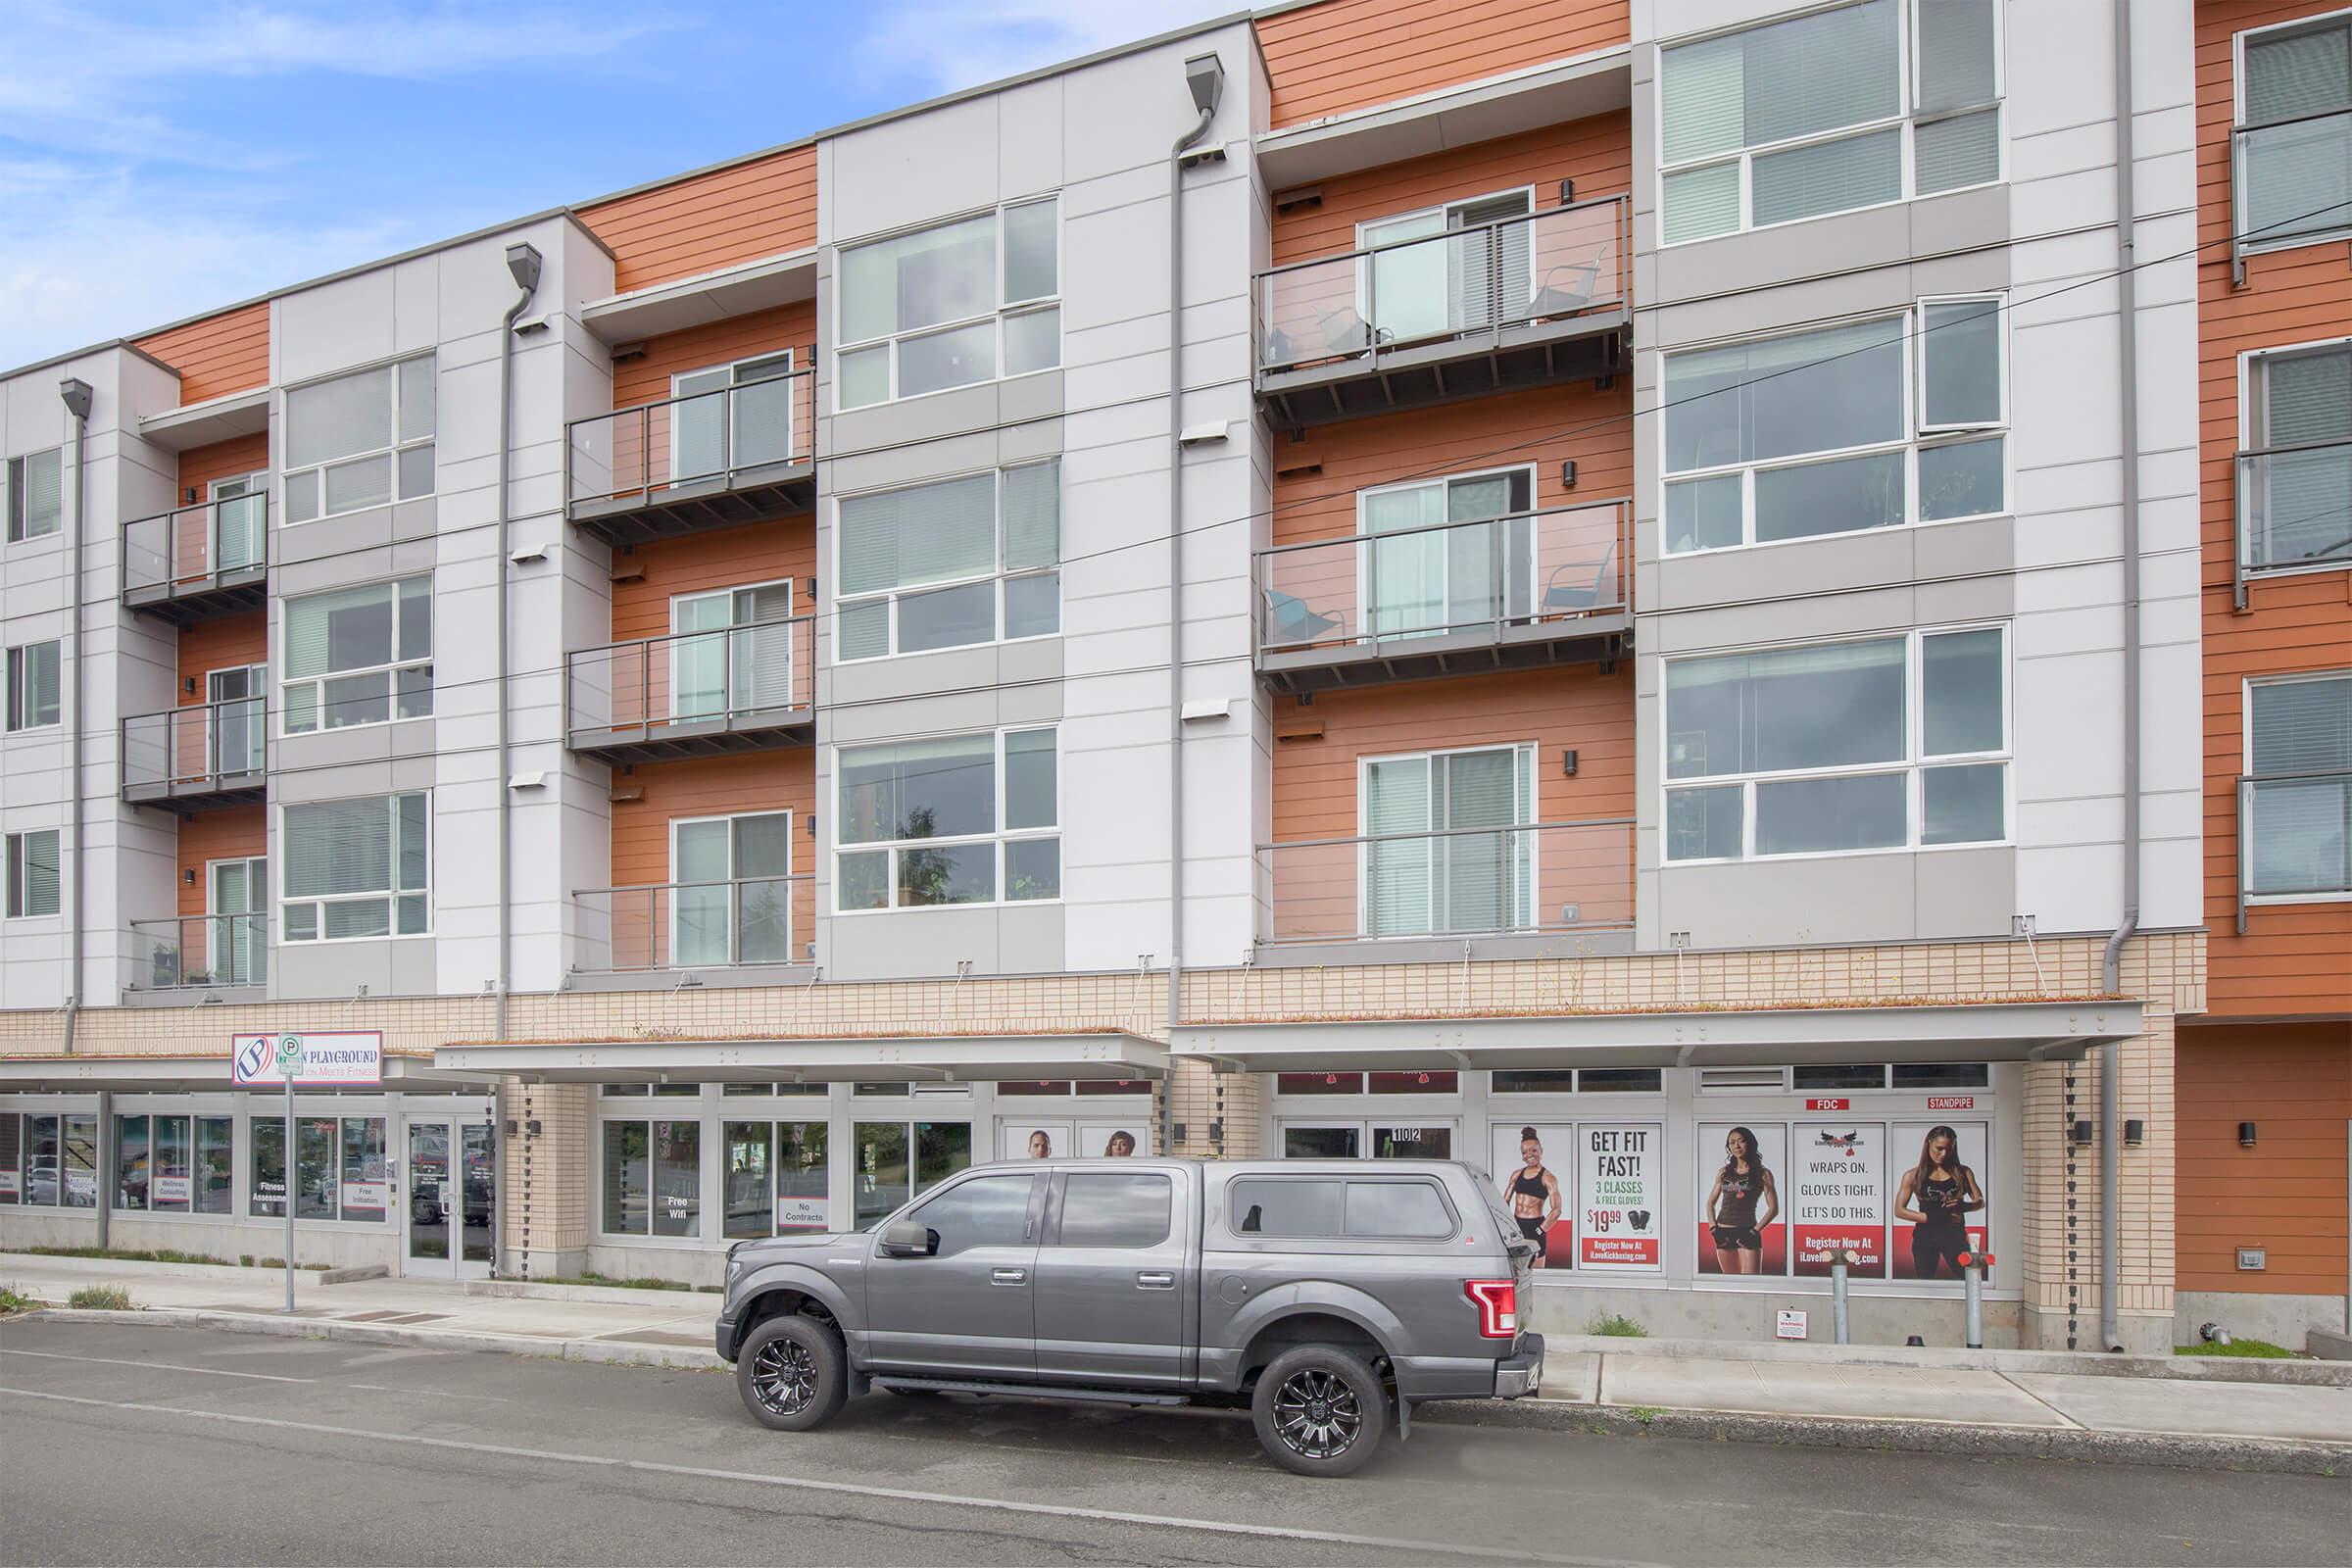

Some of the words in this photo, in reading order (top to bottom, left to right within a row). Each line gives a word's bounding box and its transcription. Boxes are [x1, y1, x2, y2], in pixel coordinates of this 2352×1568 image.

[311, 1050, 377, 1064] PLAYGROUND
[1817, 1100, 1838, 1109] FDC
[1930, 1098, 1972, 1108] STANDPIPE
[1395, 1129, 1420, 1141] 102
[1592, 1131, 1619, 1152] GET
[1624, 1131, 1646, 1152] FIT
[1598, 1155, 1641, 1176] FAST!
[1810, 1162, 1847, 1173] WRAPS
[1850, 1162, 1868, 1173] ON.
[260, 1182, 285, 1192] Fitness
[1595, 1181, 1601, 1194] 3
[1604, 1181, 1642, 1194] CLASSES
[1801, 1184, 1840, 1196] GLOVES
[1843, 1184, 1877, 1196] TIGHT.
[252, 1193, 286, 1202] Assessme
[667, 1197, 688, 1206] Free
[1595, 1196, 1600, 1204] &
[1602, 1196, 1617, 1204] FREE
[1618, 1196, 1644, 1205] GLOVES!
[799, 1202, 809, 1211] No
[668, 1209, 687, 1219] Wifi
[785, 1212, 823, 1222] Contracts
[1802, 1206, 1828, 1218] LET'S
[1832, 1207, 1846, 1218] DO
[1849, 1207, 1876, 1219] THIS.
[1594, 1240, 1619, 1250] Register
[1620, 1241, 1634, 1250] Now
[1805, 1237, 1840, 1250] Register
[1842, 1237, 1860, 1249] Now
[1862, 1237, 1872, 1249] At
